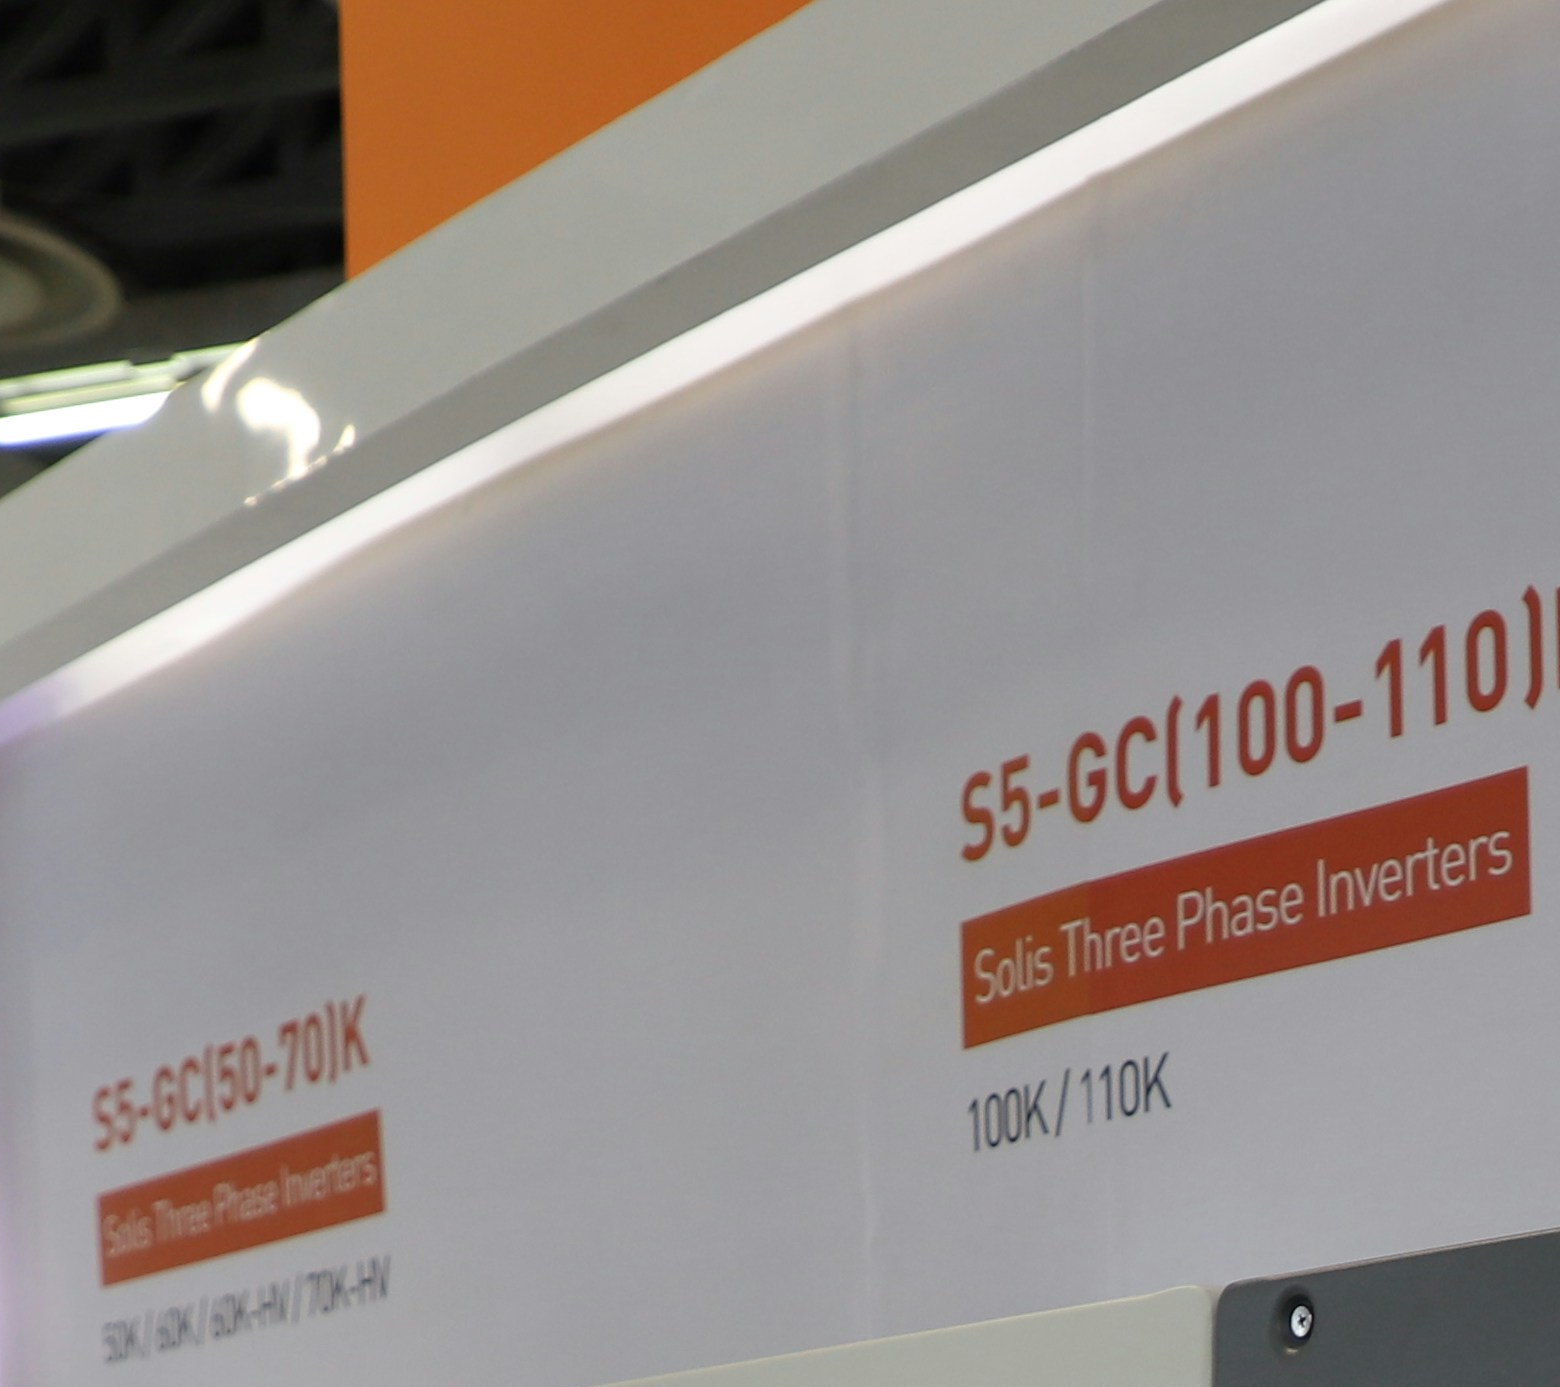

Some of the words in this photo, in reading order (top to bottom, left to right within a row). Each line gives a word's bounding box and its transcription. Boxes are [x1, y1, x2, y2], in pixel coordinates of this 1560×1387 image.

[972, 945, 1054, 1004] Solis
[1060, 914, 1166, 978] Three
[1176, 888, 1304, 950] Phase
[1316, 828, 1514, 918] Inverters
[91, 992, 372, 1153] S5-GC(50-70)K
[102, 1208, 153, 1258] Solis
[152, 1199, 212, 1242] Three
[212, 1180, 279, 1225] Phase
[280, 1151, 379, 1207] Inverters
